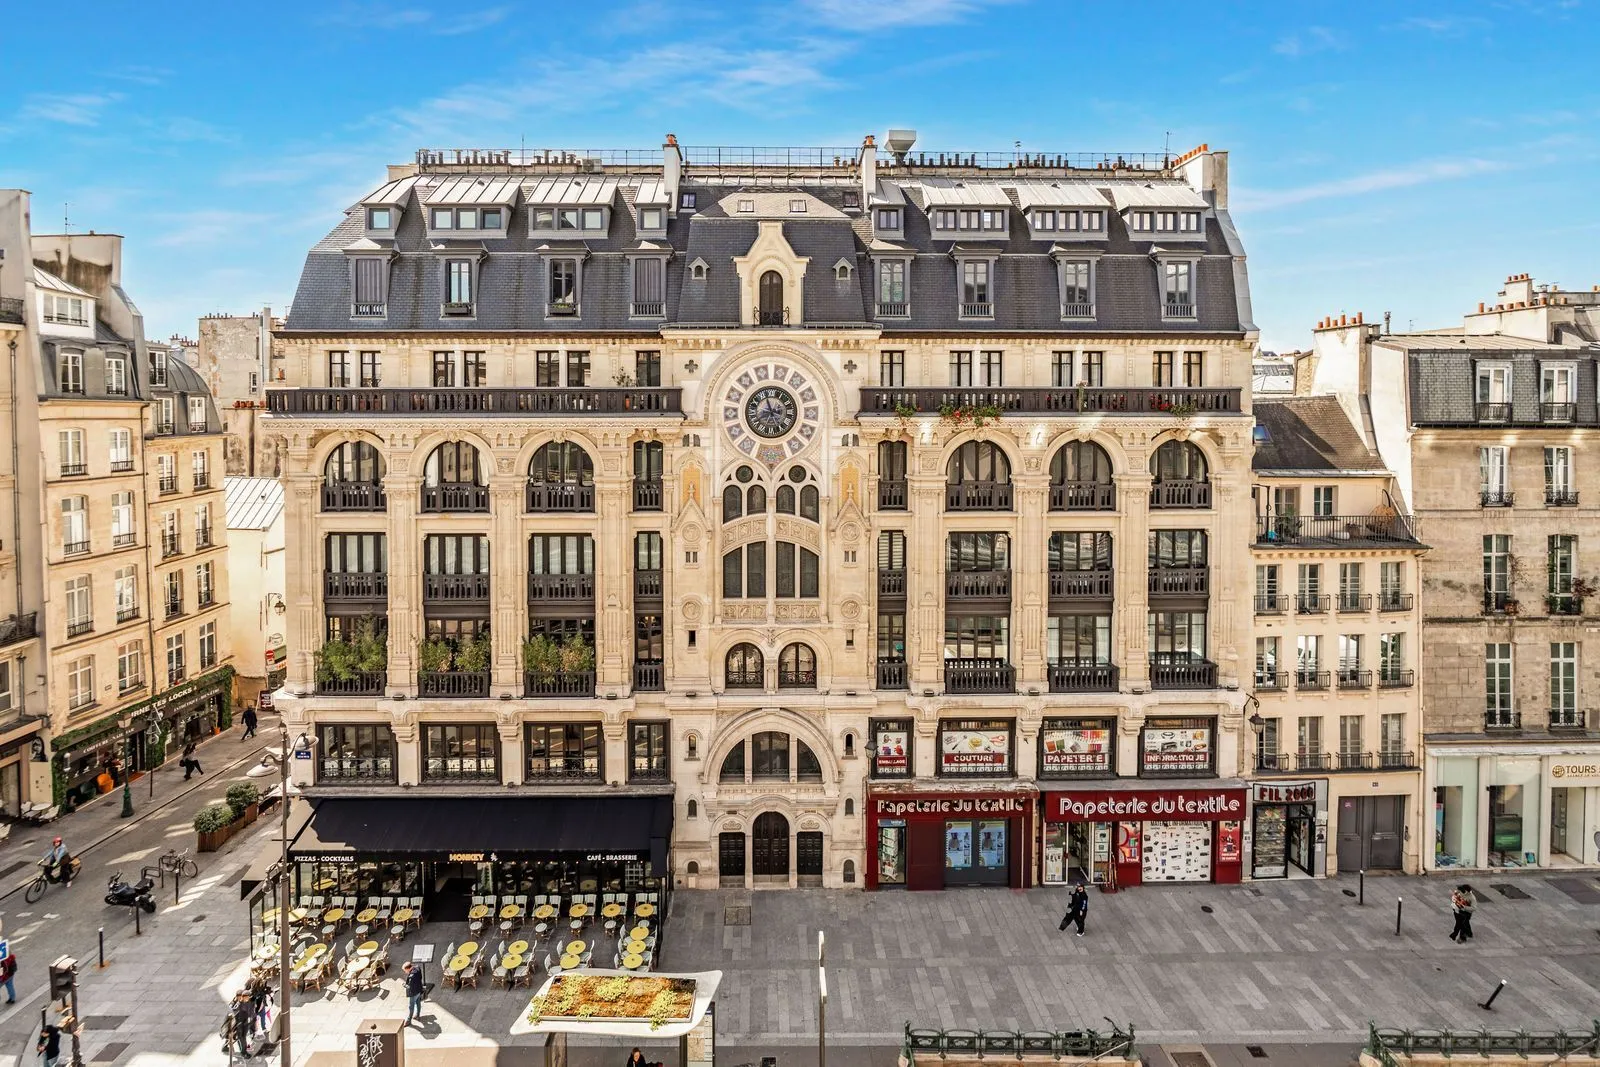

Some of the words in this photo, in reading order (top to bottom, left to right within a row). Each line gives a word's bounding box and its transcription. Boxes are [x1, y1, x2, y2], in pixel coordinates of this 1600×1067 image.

[168, 686, 192, 702] LOCKS
[1048, 754, 1102, 762] PAPETERE
[1566, 766, 1596, 774] TOURS
[1260, 787, 1282, 800] FIL
[1060, 797, 1148, 818] Papeterie
[1152, 796, 1176, 814] du
[1178, 794, 1240, 814] textile
